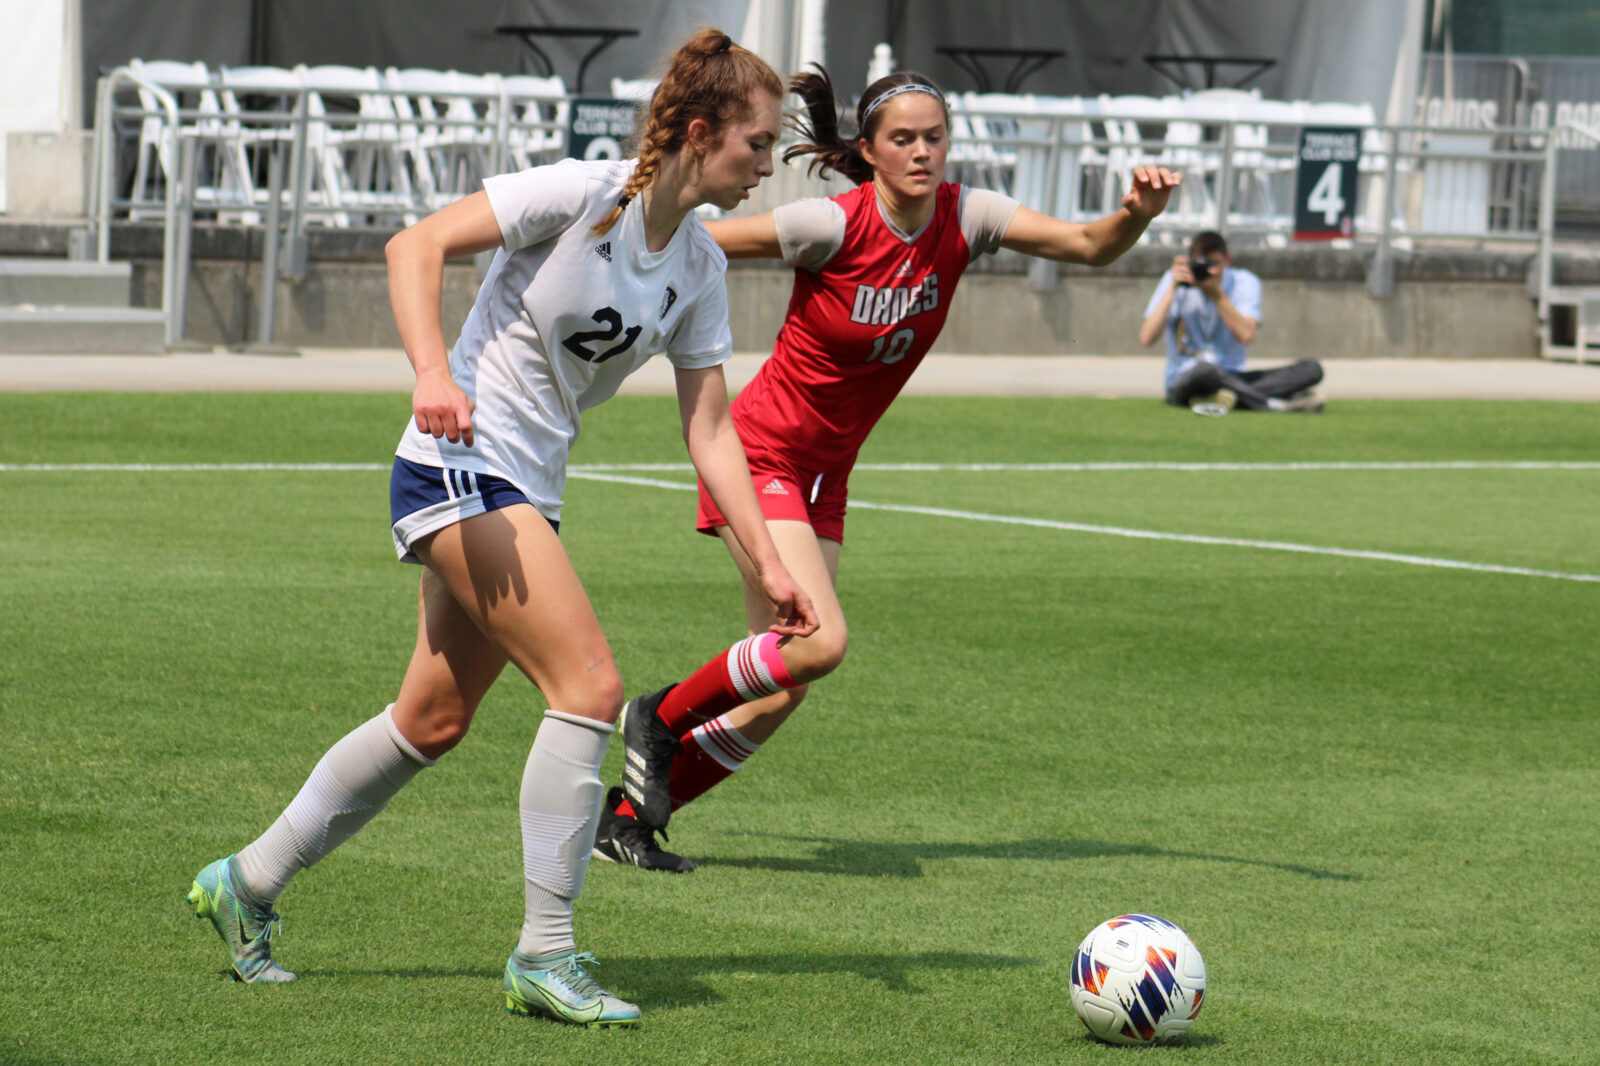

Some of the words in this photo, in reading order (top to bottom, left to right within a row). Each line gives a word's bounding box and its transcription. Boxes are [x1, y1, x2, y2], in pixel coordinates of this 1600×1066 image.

[1307, 162, 1345, 226] 4
[595, 246, 612, 263] adidas
[850, 272, 939, 326] DANES
[561, 306, 643, 364] 21
[864, 327, 916, 365] 10
